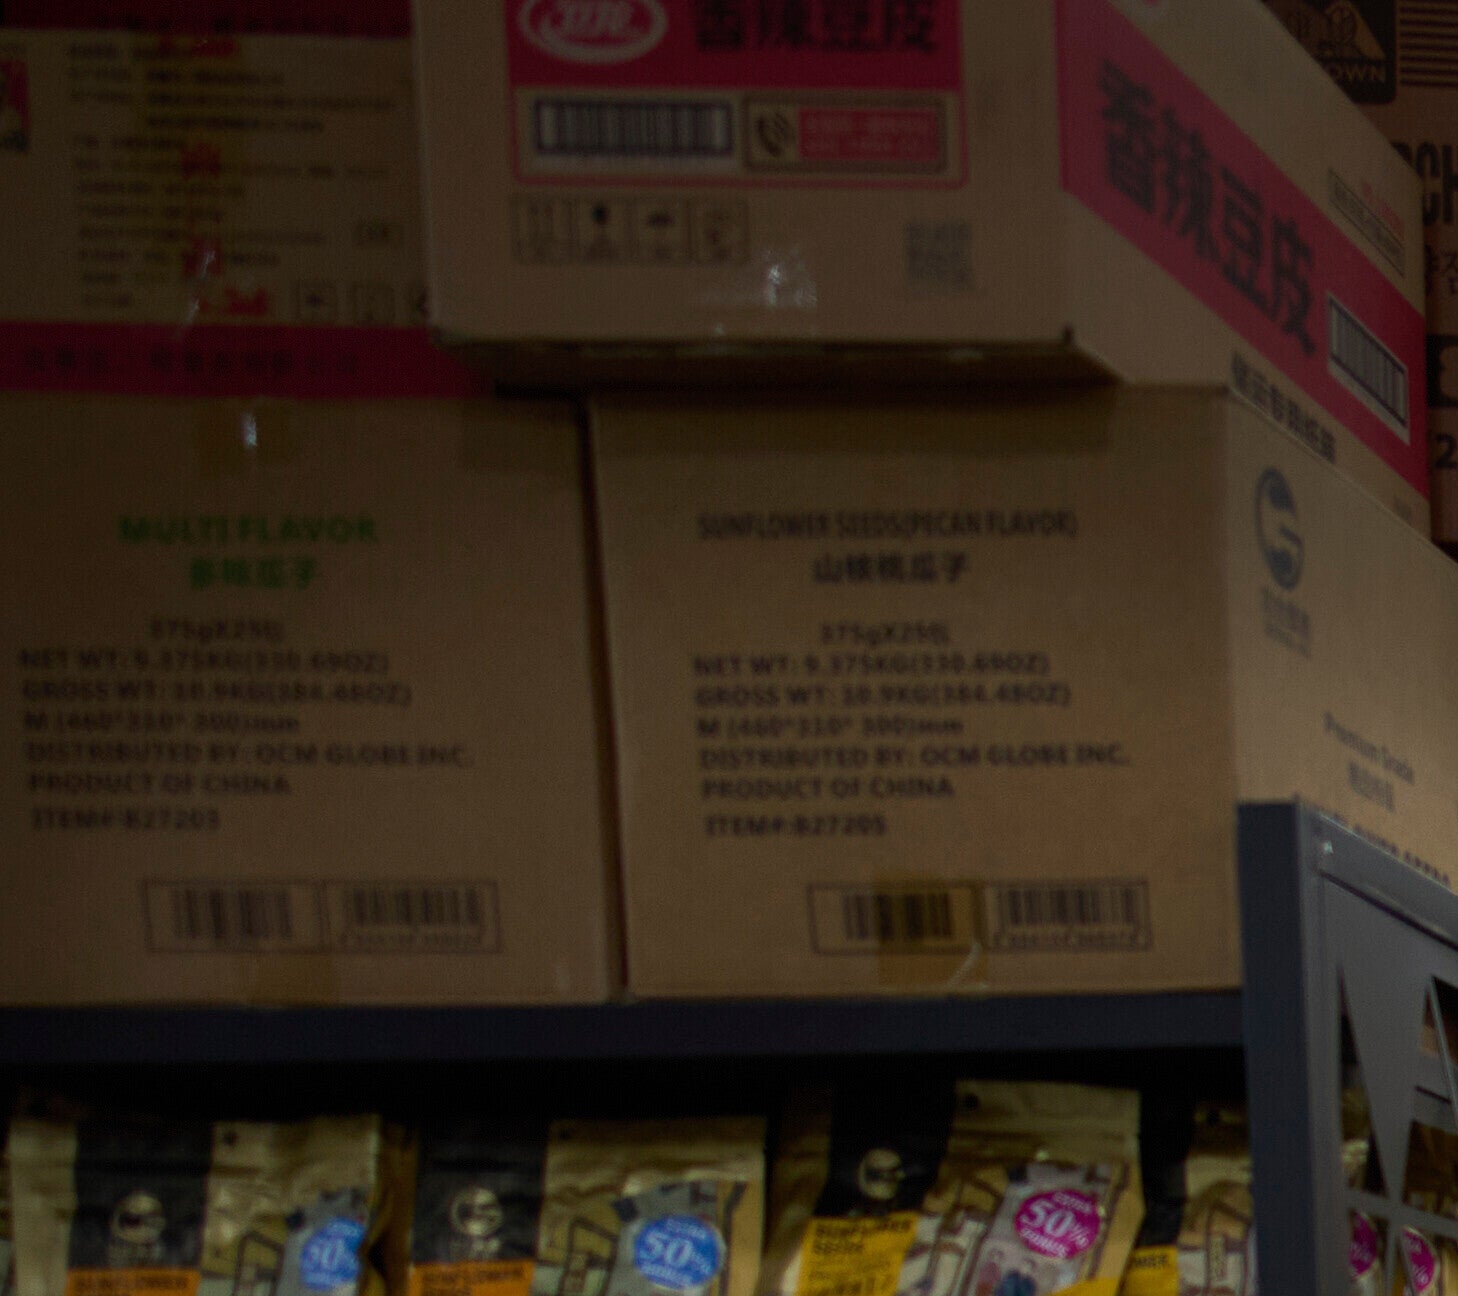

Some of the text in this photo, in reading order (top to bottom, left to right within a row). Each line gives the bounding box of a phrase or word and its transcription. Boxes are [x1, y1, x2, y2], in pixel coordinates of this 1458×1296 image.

[119, 515, 377, 544] MULTI FLAVOR
[699, 512, 828, 540] SUNFLOWER
[813, 552, 970, 585] 山核桃瓜子
[701, 777, 822, 799] PRODUCT
[869, 776, 955, 798] CHINA
